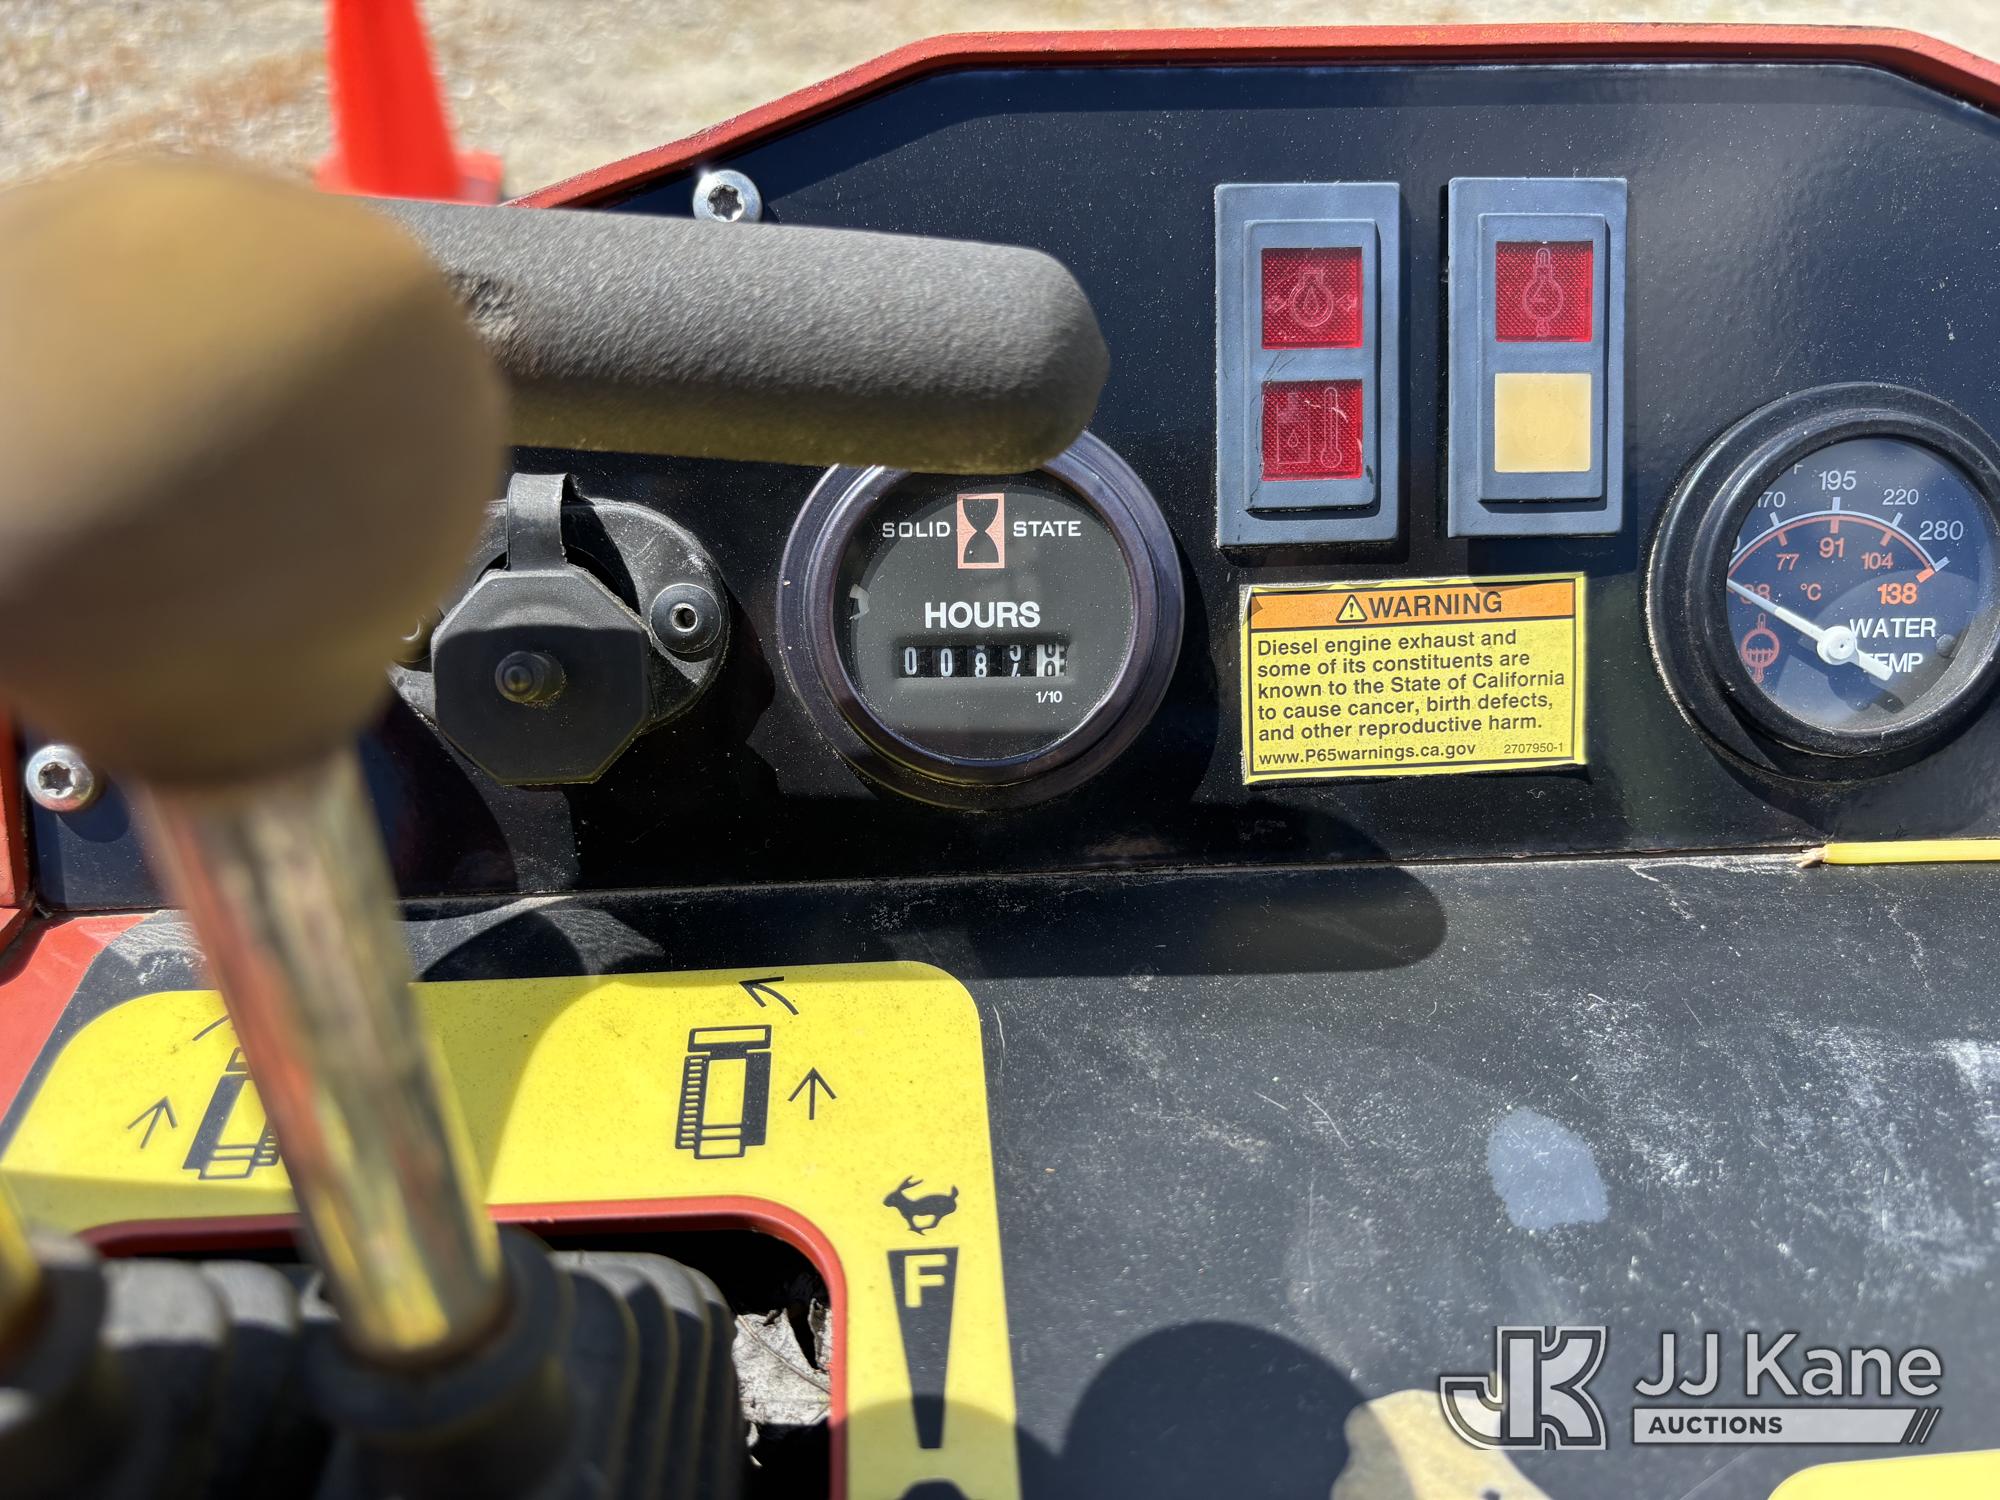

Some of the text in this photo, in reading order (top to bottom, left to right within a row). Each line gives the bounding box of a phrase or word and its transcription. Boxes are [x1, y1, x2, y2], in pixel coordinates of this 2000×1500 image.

[1818, 470, 1857, 491] 195
[1881, 488, 1919, 505] 220
[882, 520, 1082, 538] SOLID STATE
[1918, 520, 1964, 541] 280
[1819, 537, 1845, 558] 91
[1775, 553, 1800, 571] 77
[1861, 552, 1894, 570] 104
[1368, 591, 1502, 618] WARNING
[1877, 583, 1918, 605] 138
[924, 601, 1041, 629] HOURS
[1849, 617, 1937, 638] WATER
[1257, 629, 1517, 656] Diesel engine exhaust and
[1257, 652, 1530, 678] some of its constituents are
[1257, 669, 1565, 699] known to the State of California
[1035, 690, 1064, 704] 1/10
[1257, 693, 1554, 720] to cause cancer, birth defects,
[1258, 714, 1543, 742] and other reproductive harm.
[1258, 742, 1564, 765] www.P65warnings.ca.gov 2707950-1
[904, 1253, 948, 1307] F
